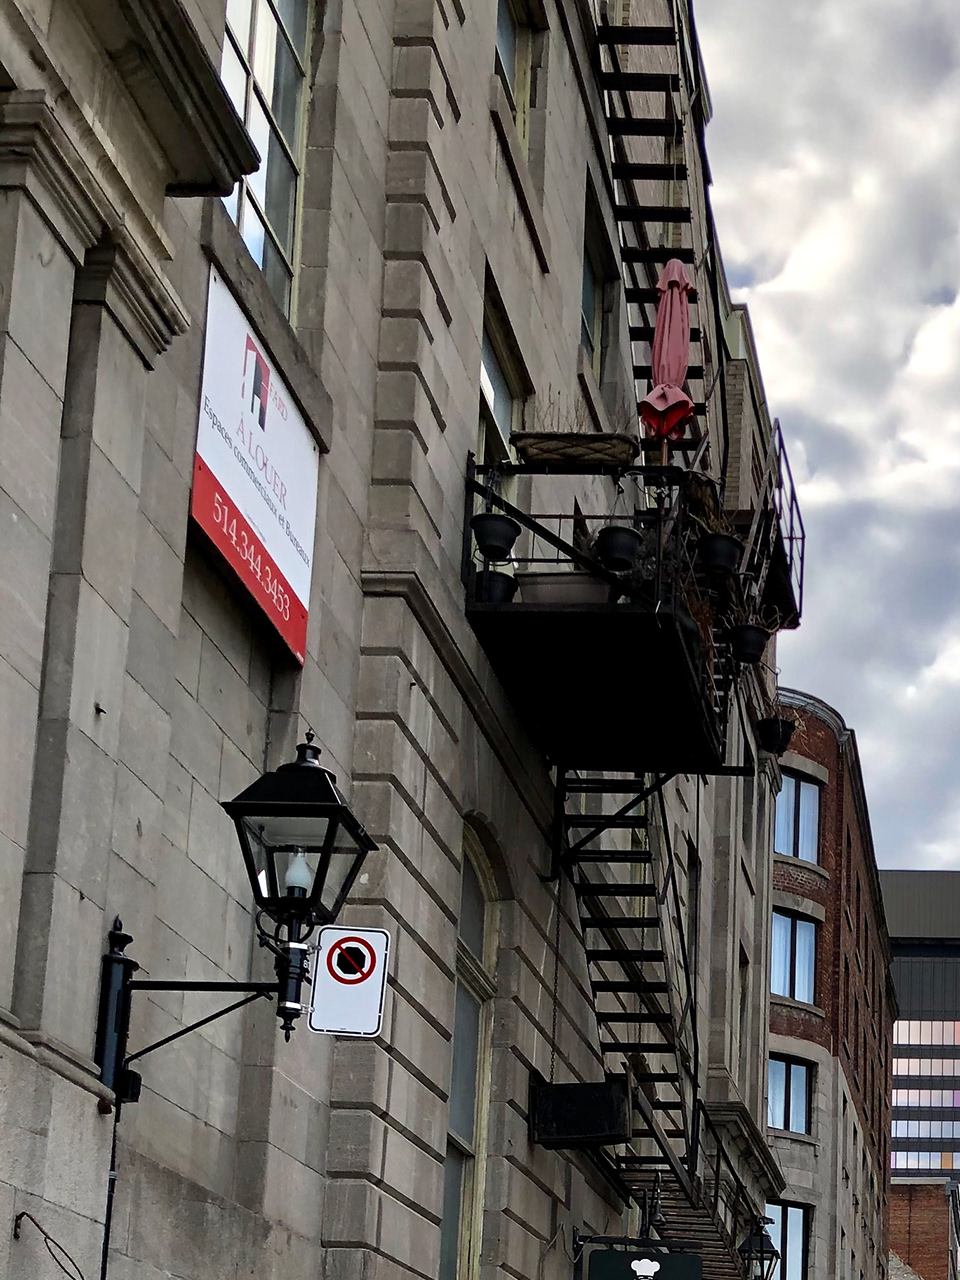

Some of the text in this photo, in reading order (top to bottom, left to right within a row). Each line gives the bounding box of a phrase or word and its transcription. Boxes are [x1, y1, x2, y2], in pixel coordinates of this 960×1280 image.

[203, 395, 233, 449] Espaces
[233, 445, 278, 518] commerciaux
[278, 513, 285, 530] et
[285, 521, 311, 569] Bureaux
[248, 430, 288, 510] LOUER
[213, 492, 290, 621] 514.344.3453
